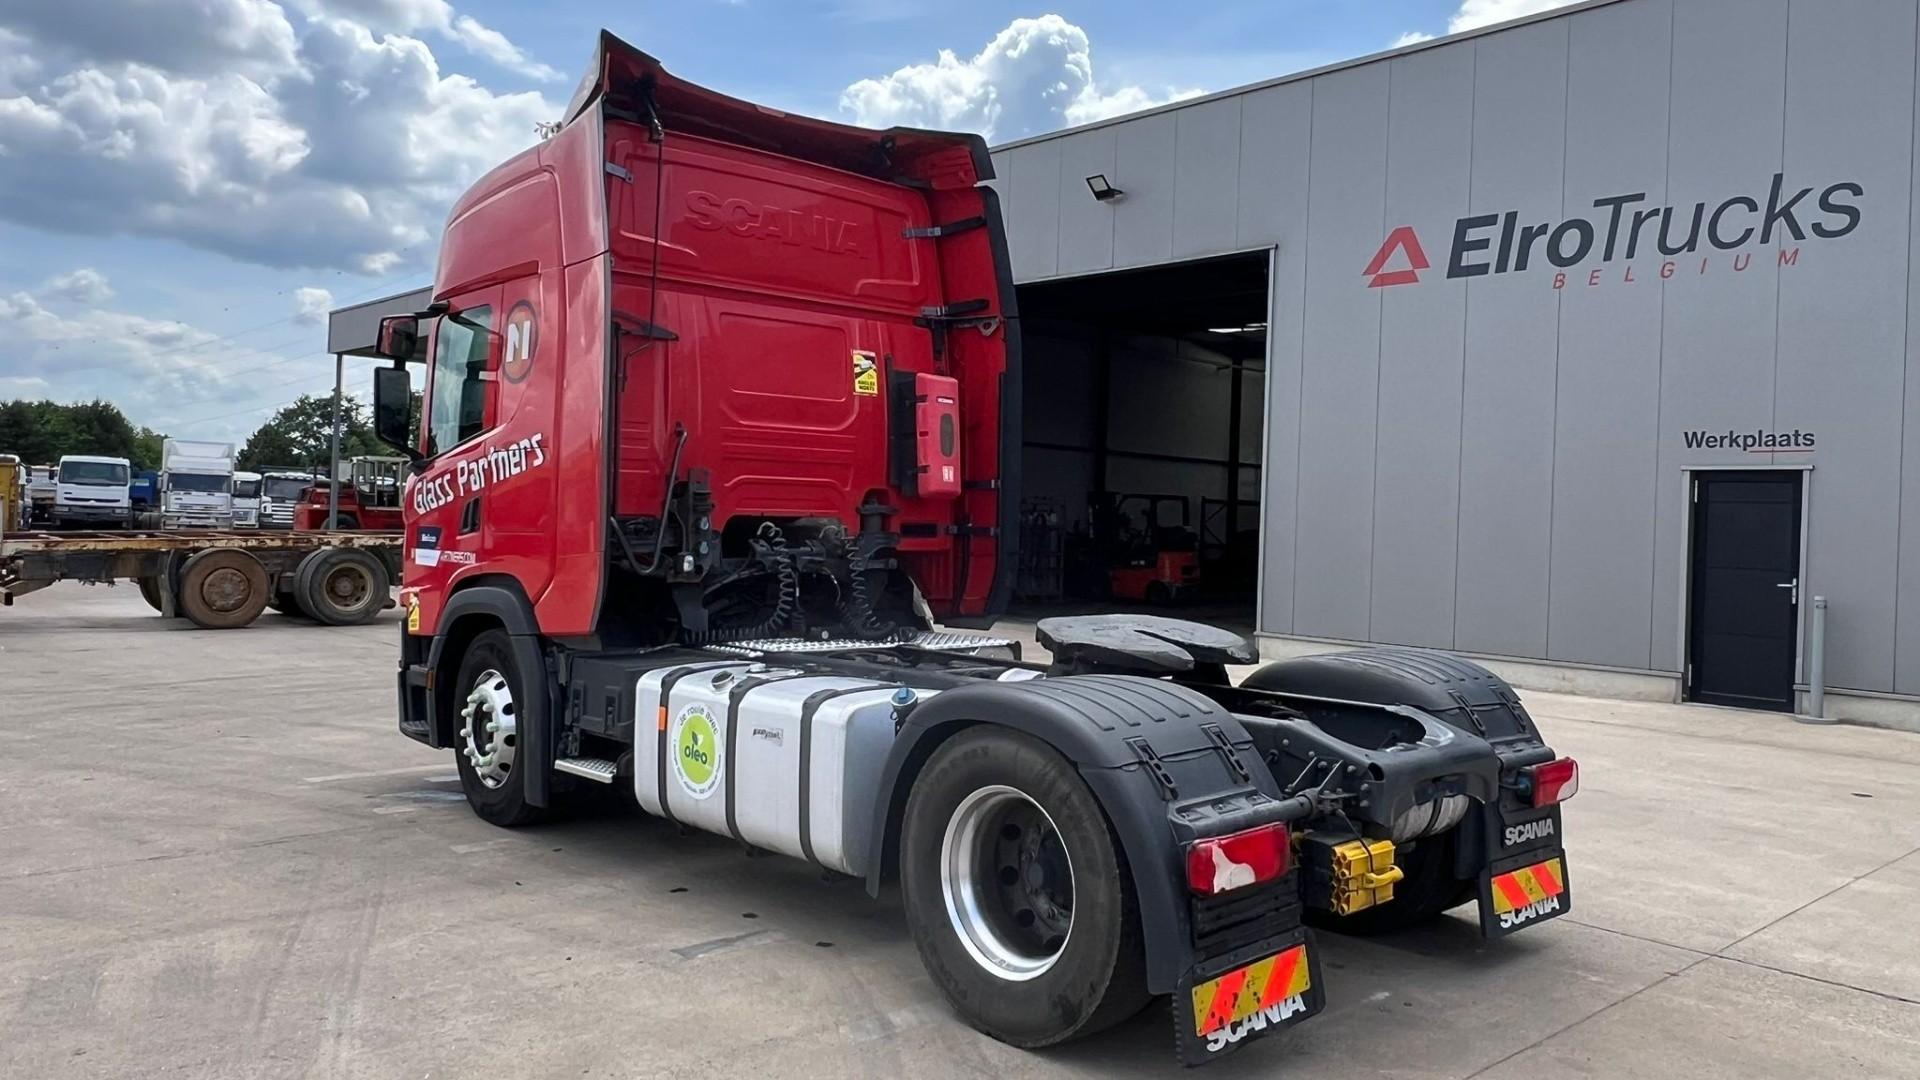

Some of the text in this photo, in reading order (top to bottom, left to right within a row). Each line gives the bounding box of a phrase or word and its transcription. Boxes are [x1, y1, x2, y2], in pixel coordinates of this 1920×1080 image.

[684, 190, 870, 260] SCANIA
[1446, 172, 1864, 279] ElroTrucks
[1551, 247, 1799, 290] BELGIUM
[1683, 429, 1815, 452] Werkplaats
[414, 433, 545, 515] Glass Partners
[684, 743, 708, 765] oleo
[1505, 818, 1554, 846] SCANIA
